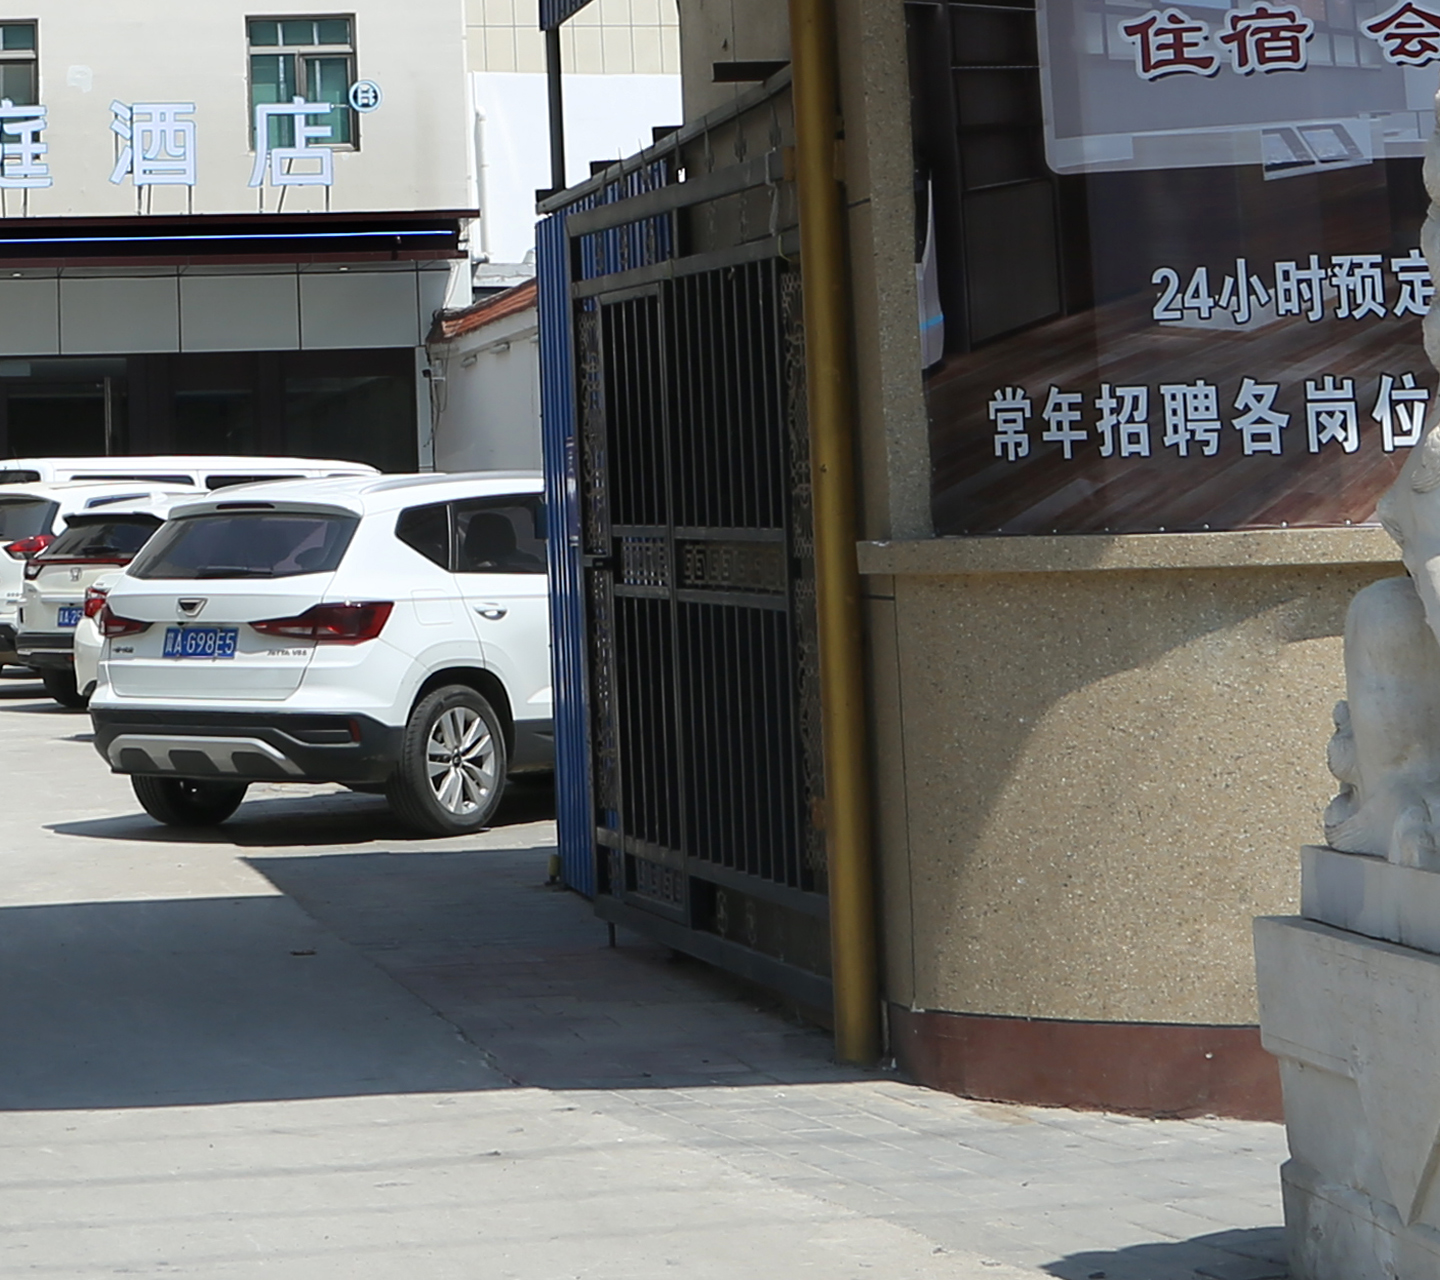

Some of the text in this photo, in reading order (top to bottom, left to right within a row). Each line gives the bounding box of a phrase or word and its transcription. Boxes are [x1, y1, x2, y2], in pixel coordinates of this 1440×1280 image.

[1123, 6, 1312, 80] 住宿
[1151, 249, 1436, 323] 24小时预定
[988, 373, 1429, 461] 常年招聘各岗位
